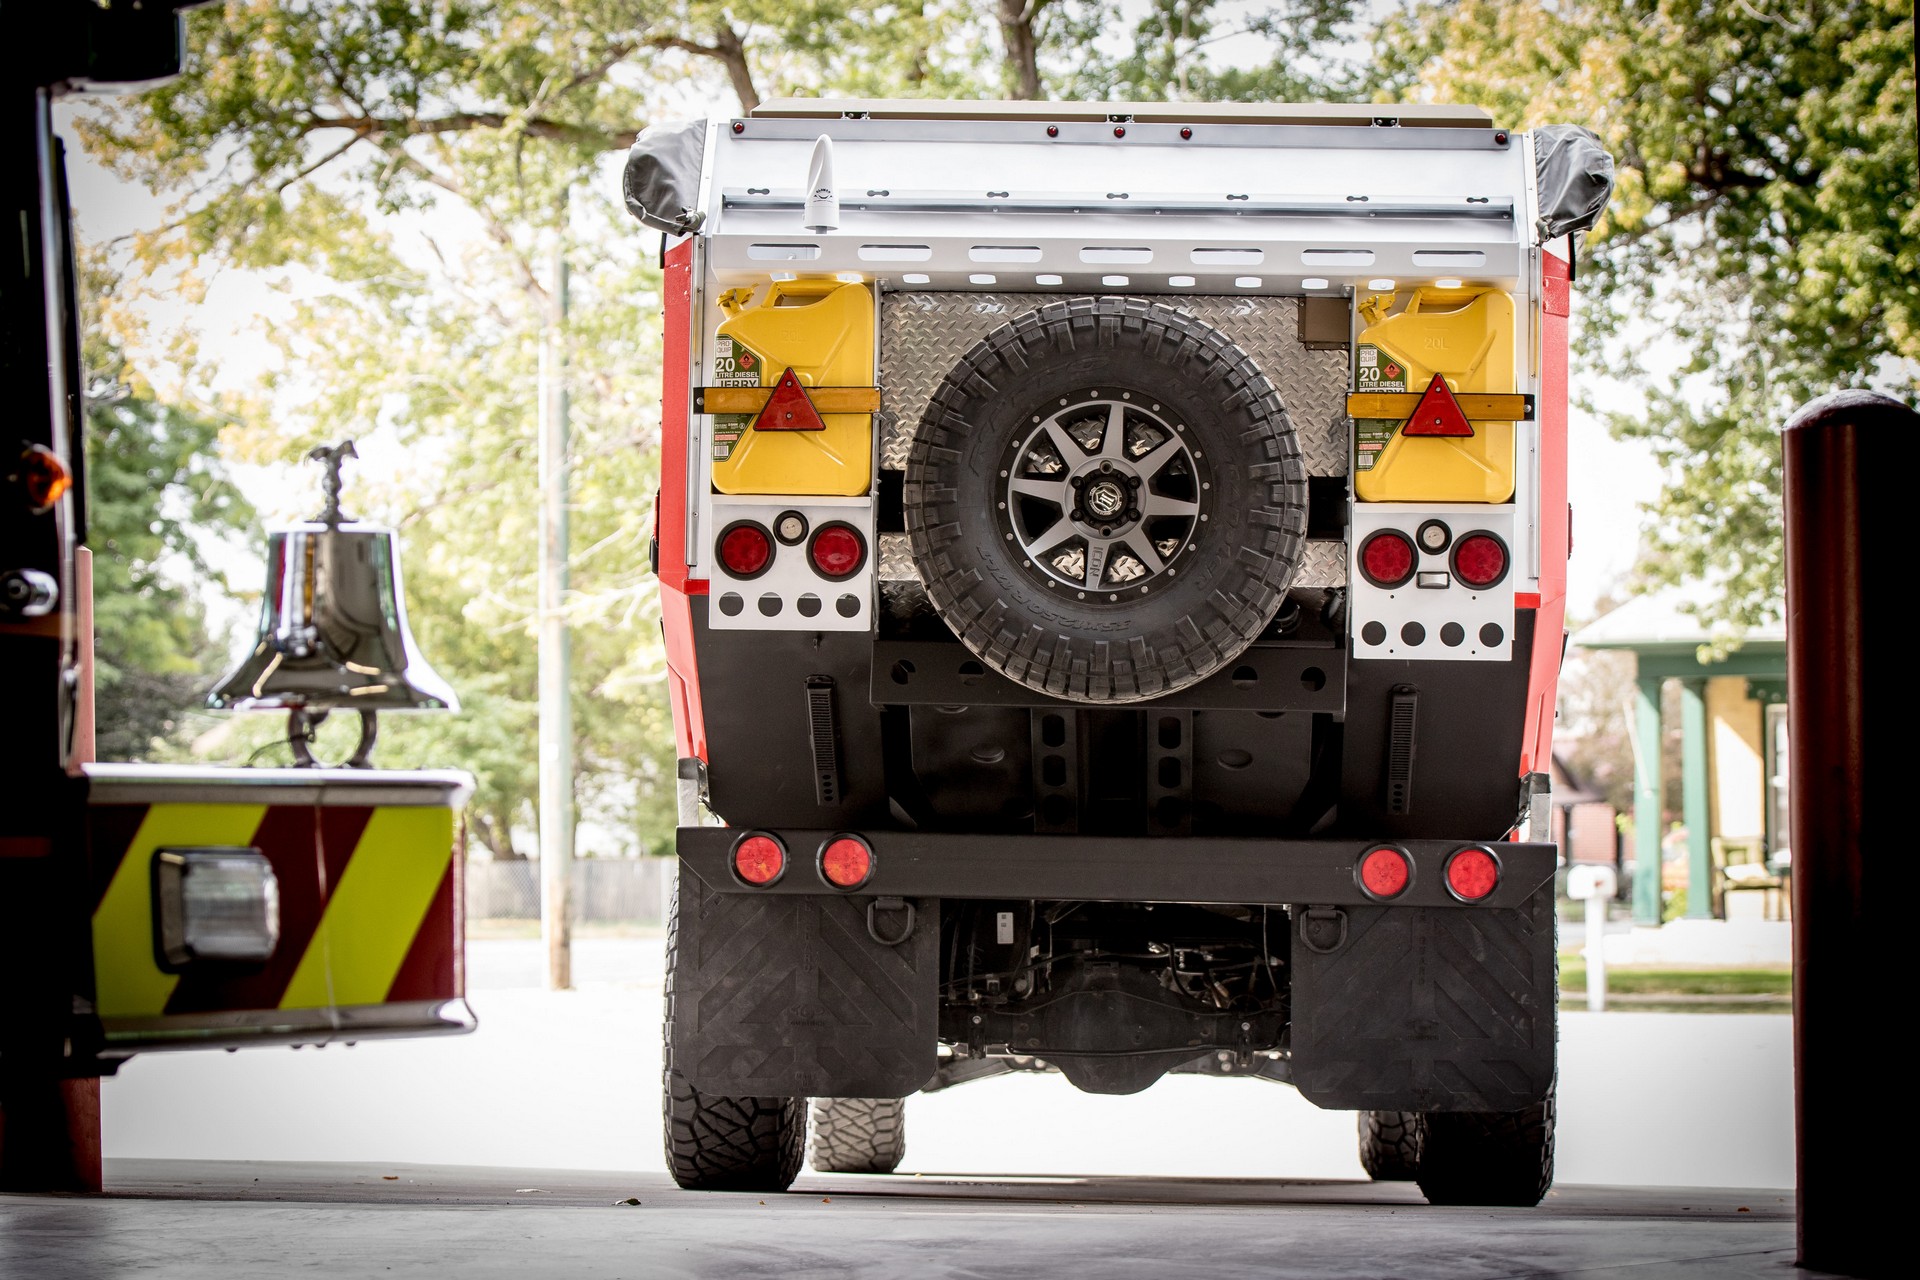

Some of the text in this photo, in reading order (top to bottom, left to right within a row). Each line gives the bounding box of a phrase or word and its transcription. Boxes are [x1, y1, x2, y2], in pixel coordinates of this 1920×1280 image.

[1425, 338, 1448, 350] 20L
[716, 358, 735, 372] 20
[1359, 367, 1381, 381] 20
[1089, 546, 1104, 577] ICON
